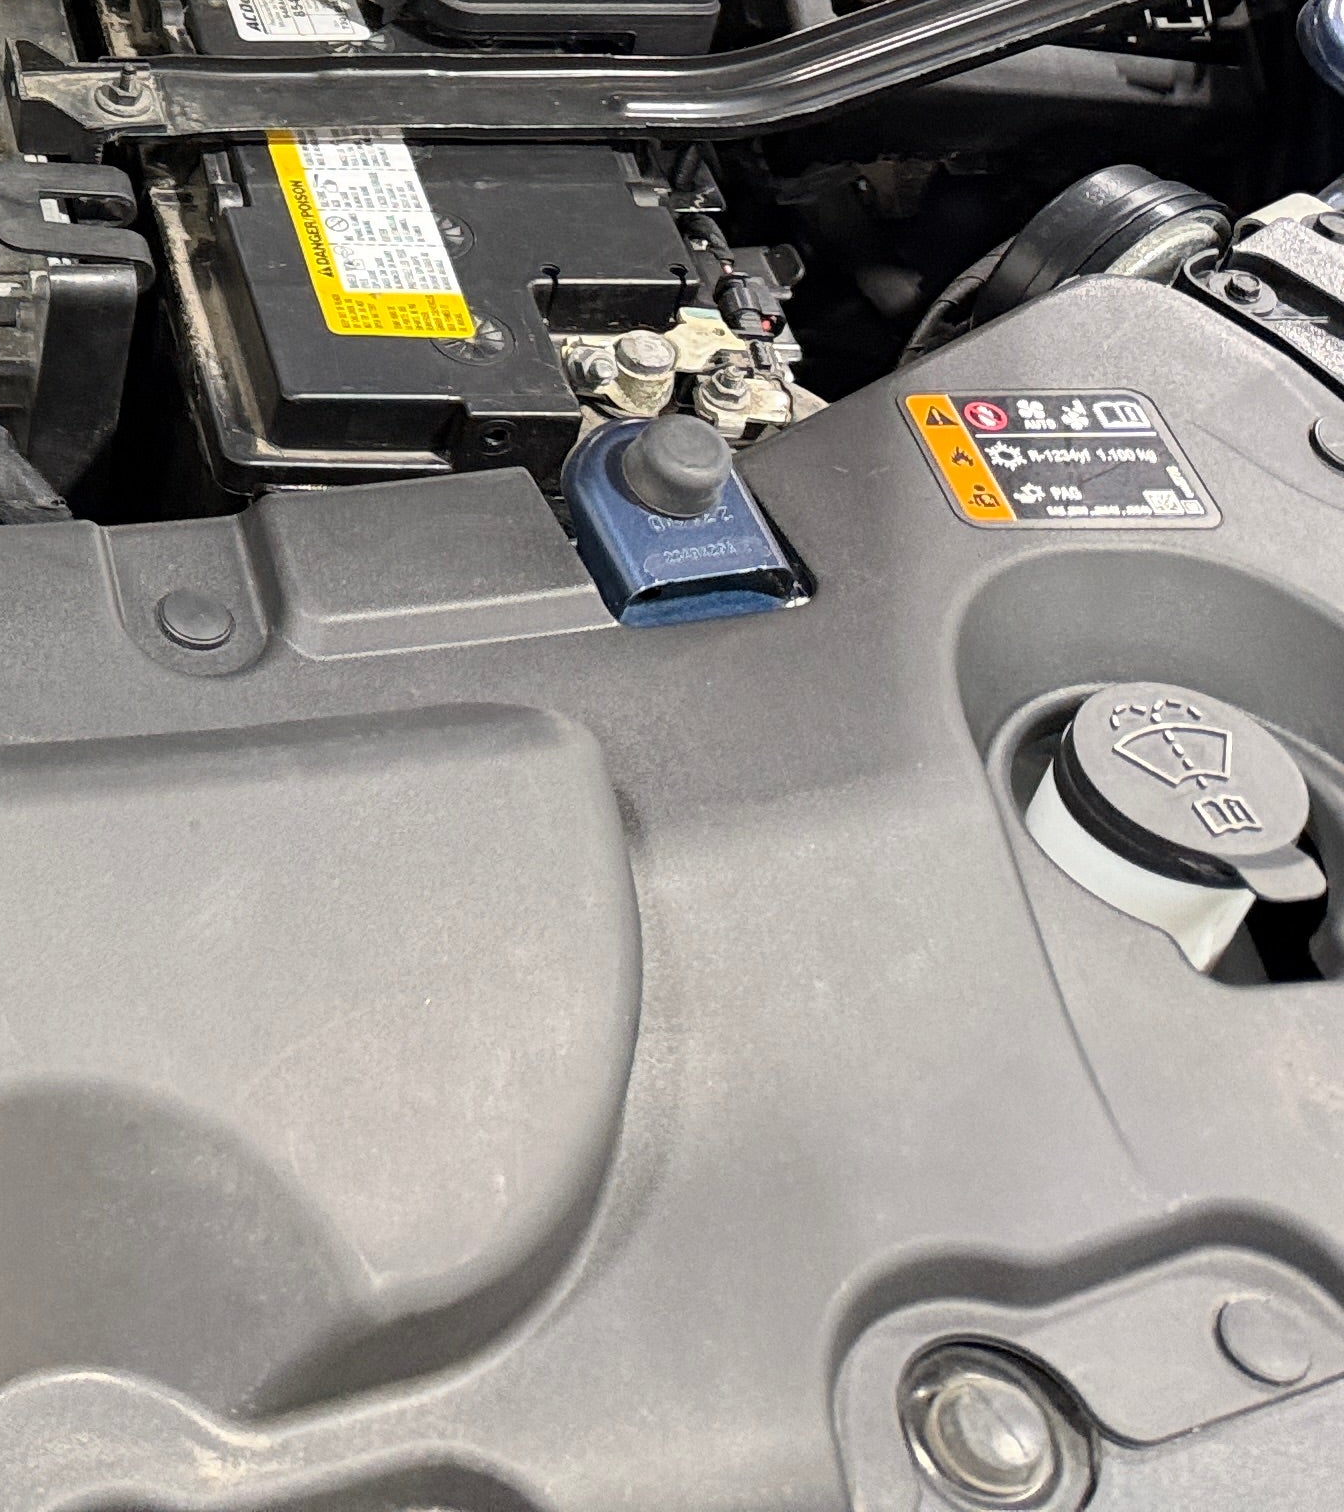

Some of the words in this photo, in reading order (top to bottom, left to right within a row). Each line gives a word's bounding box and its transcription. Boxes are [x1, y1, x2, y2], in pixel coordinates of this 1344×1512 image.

[288, 180, 330, 266] DANGER/POISON
[1024, 418, 1057, 430] AUTO
[1096, 447, 1136, 463] 1.100
[1050, 485, 1083, 501] PAG
